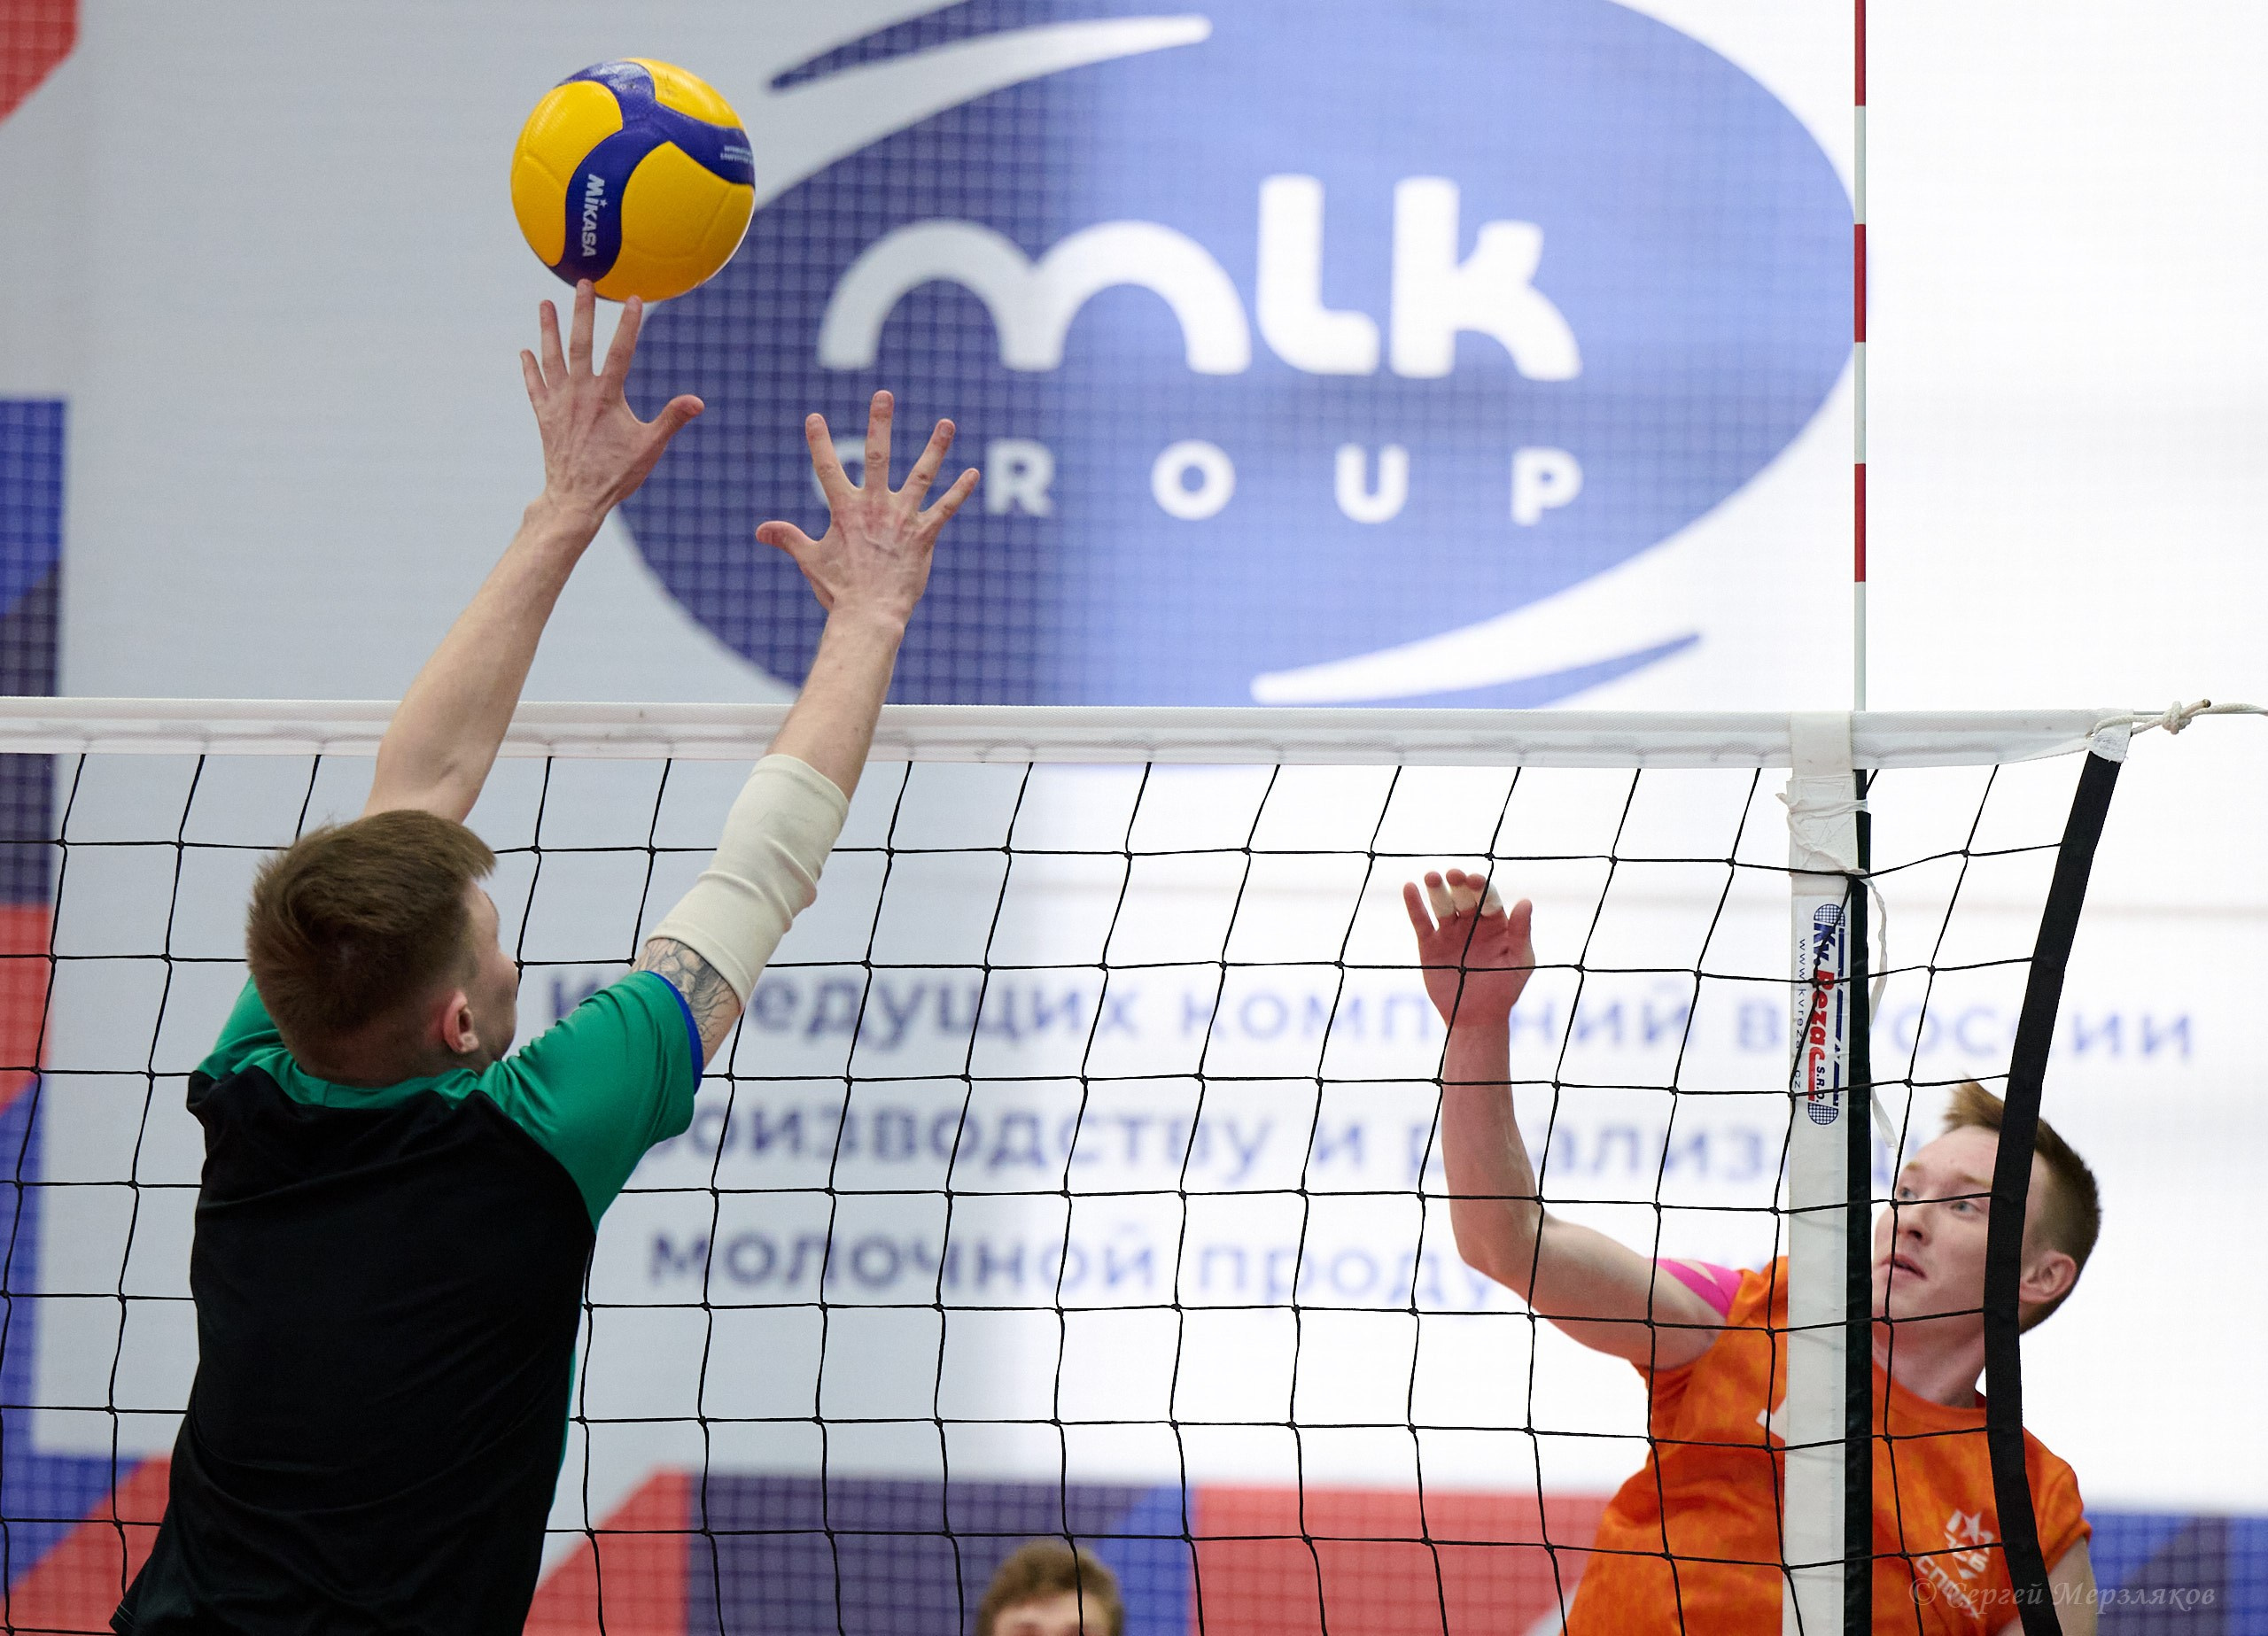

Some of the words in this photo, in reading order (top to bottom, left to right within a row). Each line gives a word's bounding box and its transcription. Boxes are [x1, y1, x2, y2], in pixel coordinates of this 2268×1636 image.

[753, 973, 1143, 1048] едущих
[1180, 979, 1696, 1051] компний
[1872, 1001, 2194, 1065] осии
[1312, 1118, 1364, 1167] и
[649, 1225, 1155, 1291] молочной
